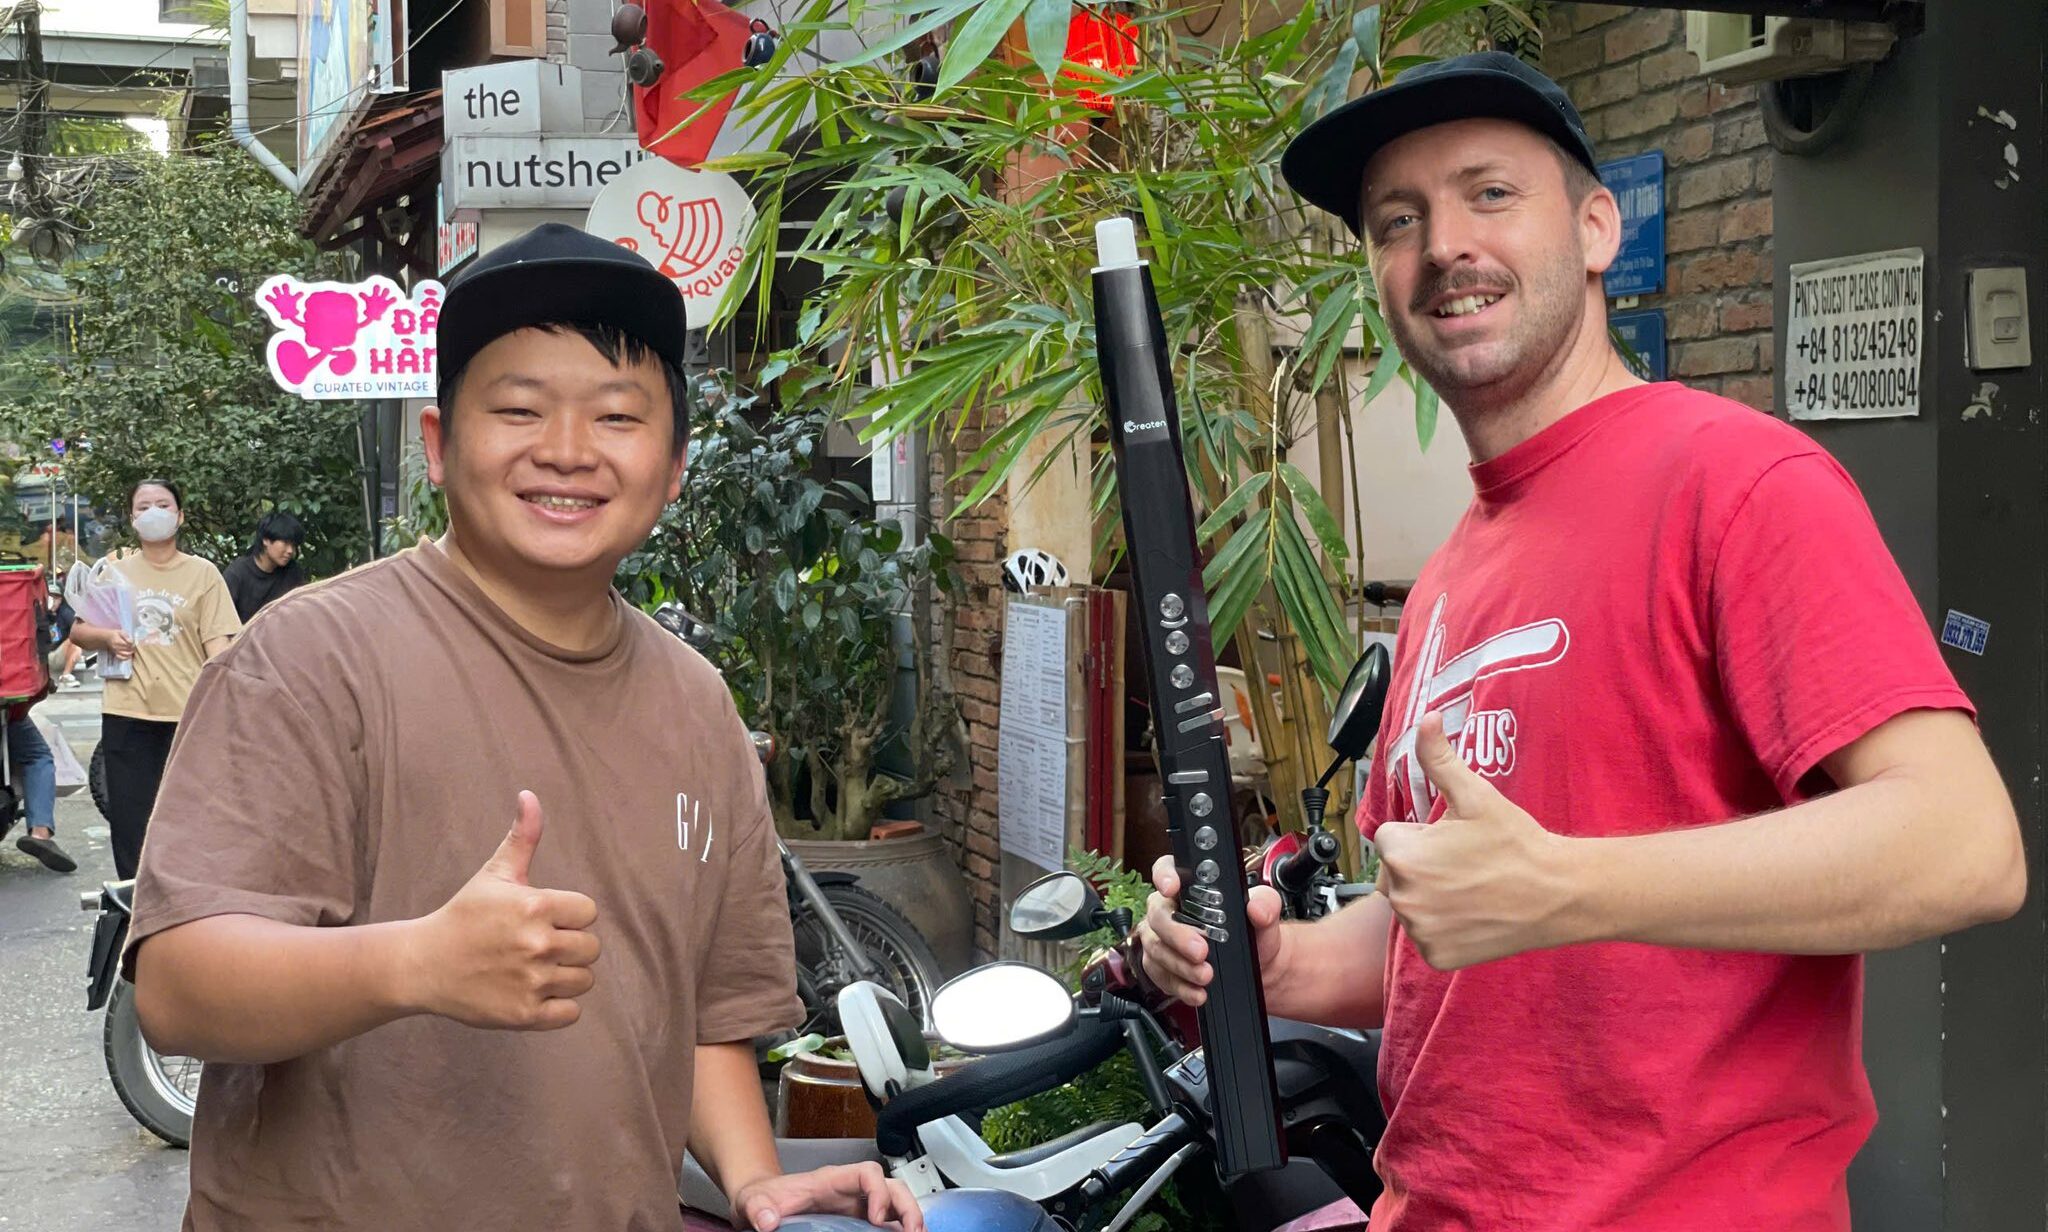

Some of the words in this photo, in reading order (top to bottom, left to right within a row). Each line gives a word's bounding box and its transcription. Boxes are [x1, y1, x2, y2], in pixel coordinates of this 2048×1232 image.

[464, 83, 520, 119] the
[467, 150, 643, 188] nutshe
[1821, 275, 1847, 315] GUEST
[1849, 271, 1879, 312] PLEASE
[1882, 266, 1921, 309] CONTACT
[1796, 326, 1827, 364] +84
[1832, 317, 1917, 363] 813245248
[313, 381, 373, 394] CURATED
[376, 380, 429, 393] VINTAGE
[1794, 373, 1827, 410] +84
[1832, 366, 1917, 410] 942080094
[1455, 708, 1516, 774] CUS
